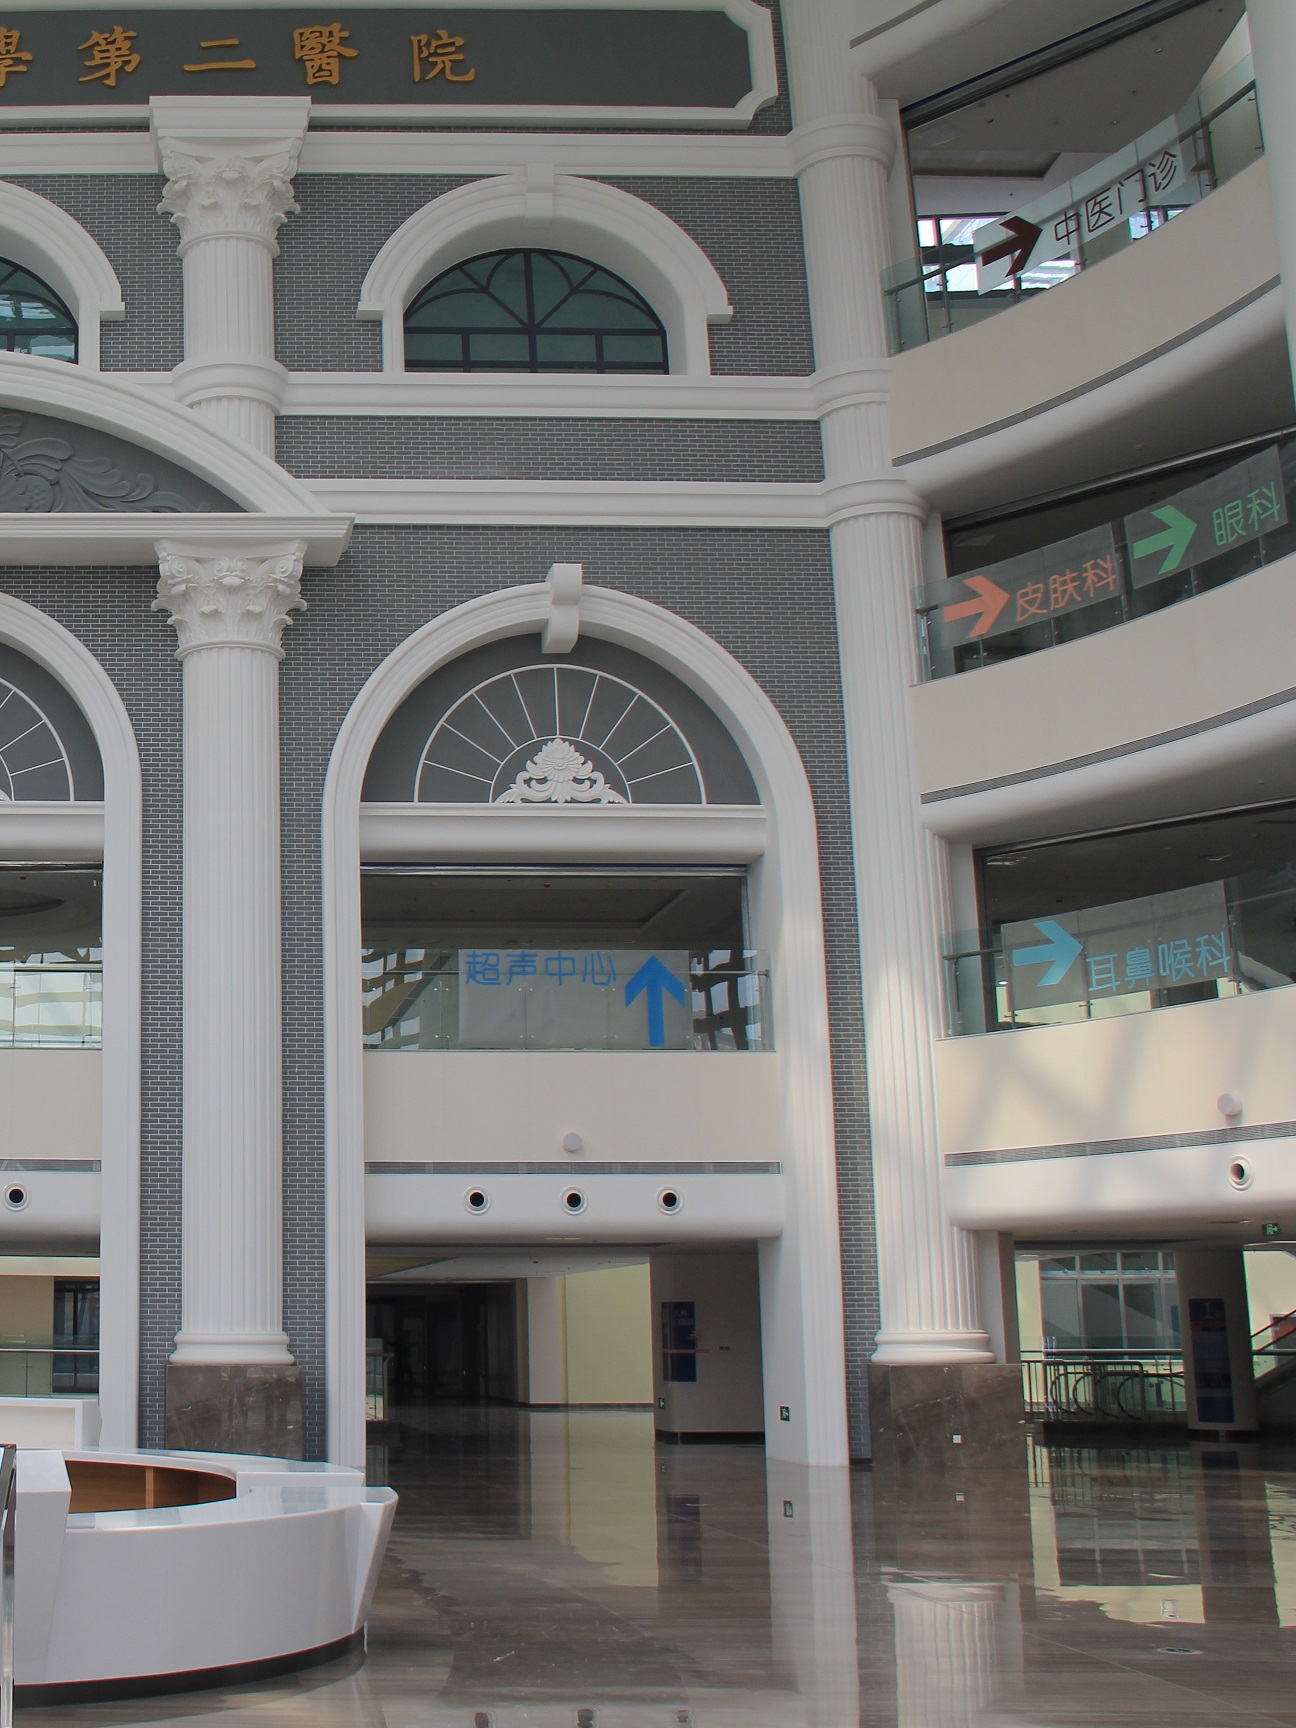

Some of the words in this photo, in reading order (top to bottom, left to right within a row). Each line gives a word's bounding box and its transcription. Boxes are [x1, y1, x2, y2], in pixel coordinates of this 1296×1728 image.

[1055, 151, 1177, 245] 中医门诊
[1212, 481, 1281, 546] 眼科
[1016, 554, 1117, 622] 皮肤科
[465, 950, 617, 986] 超声中心
[1085, 931, 1231, 991] 耳鼻喉科
